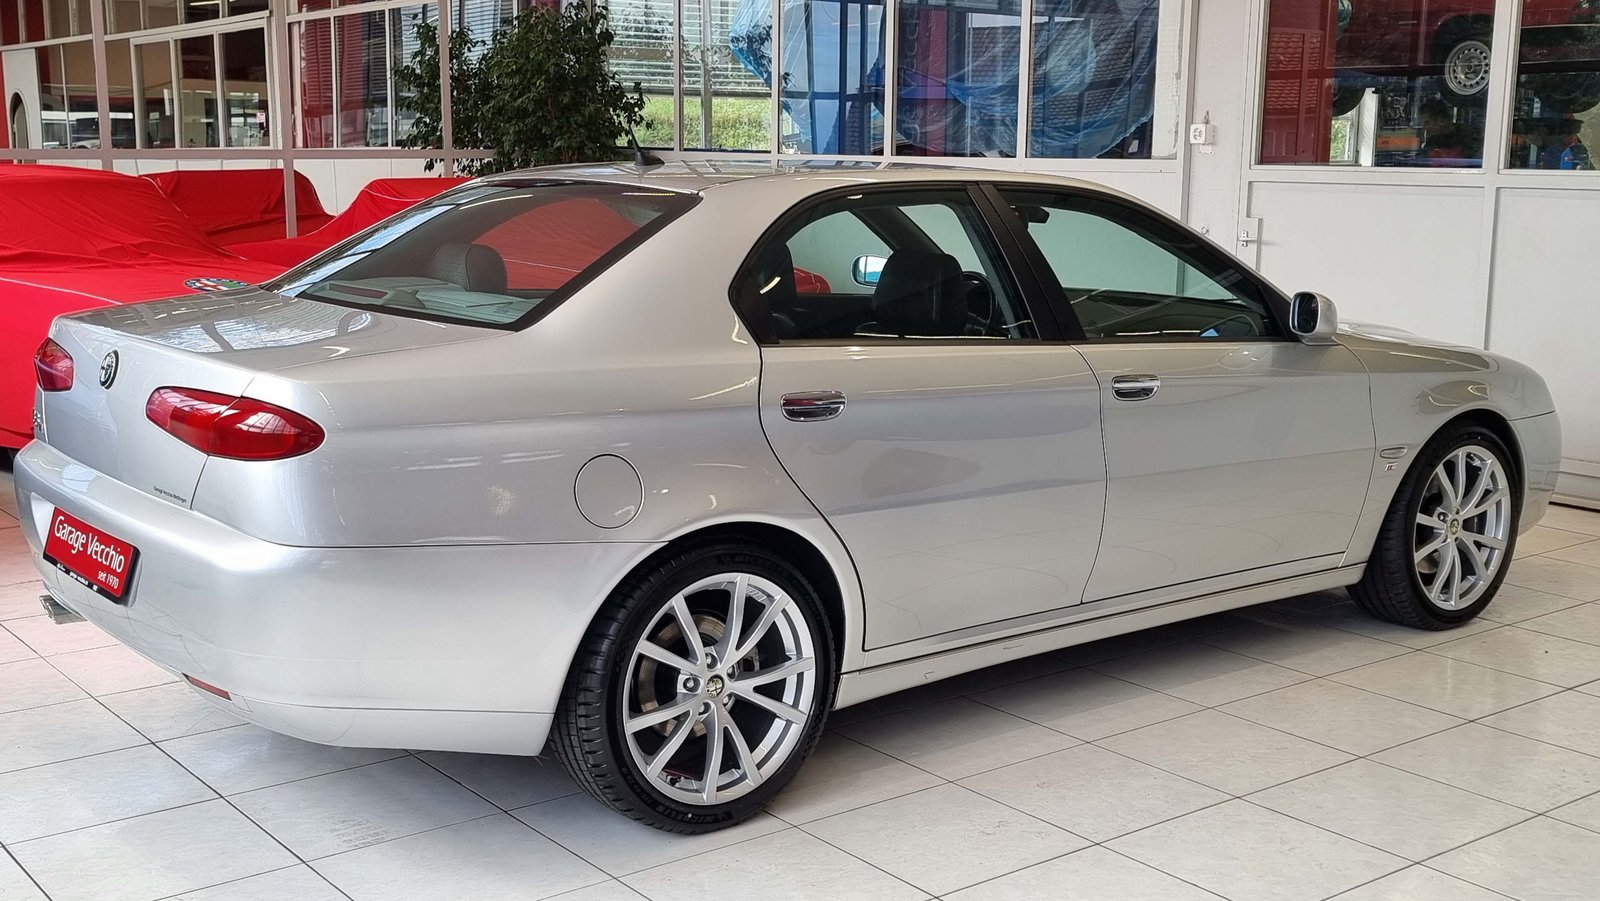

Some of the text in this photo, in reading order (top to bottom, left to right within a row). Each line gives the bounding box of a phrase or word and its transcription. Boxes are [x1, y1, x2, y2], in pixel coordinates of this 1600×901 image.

[54, 515, 125, 573] Garage Vecchio
[97, 570, 107, 583] seit
[106, 572, 120, 590] 1970
